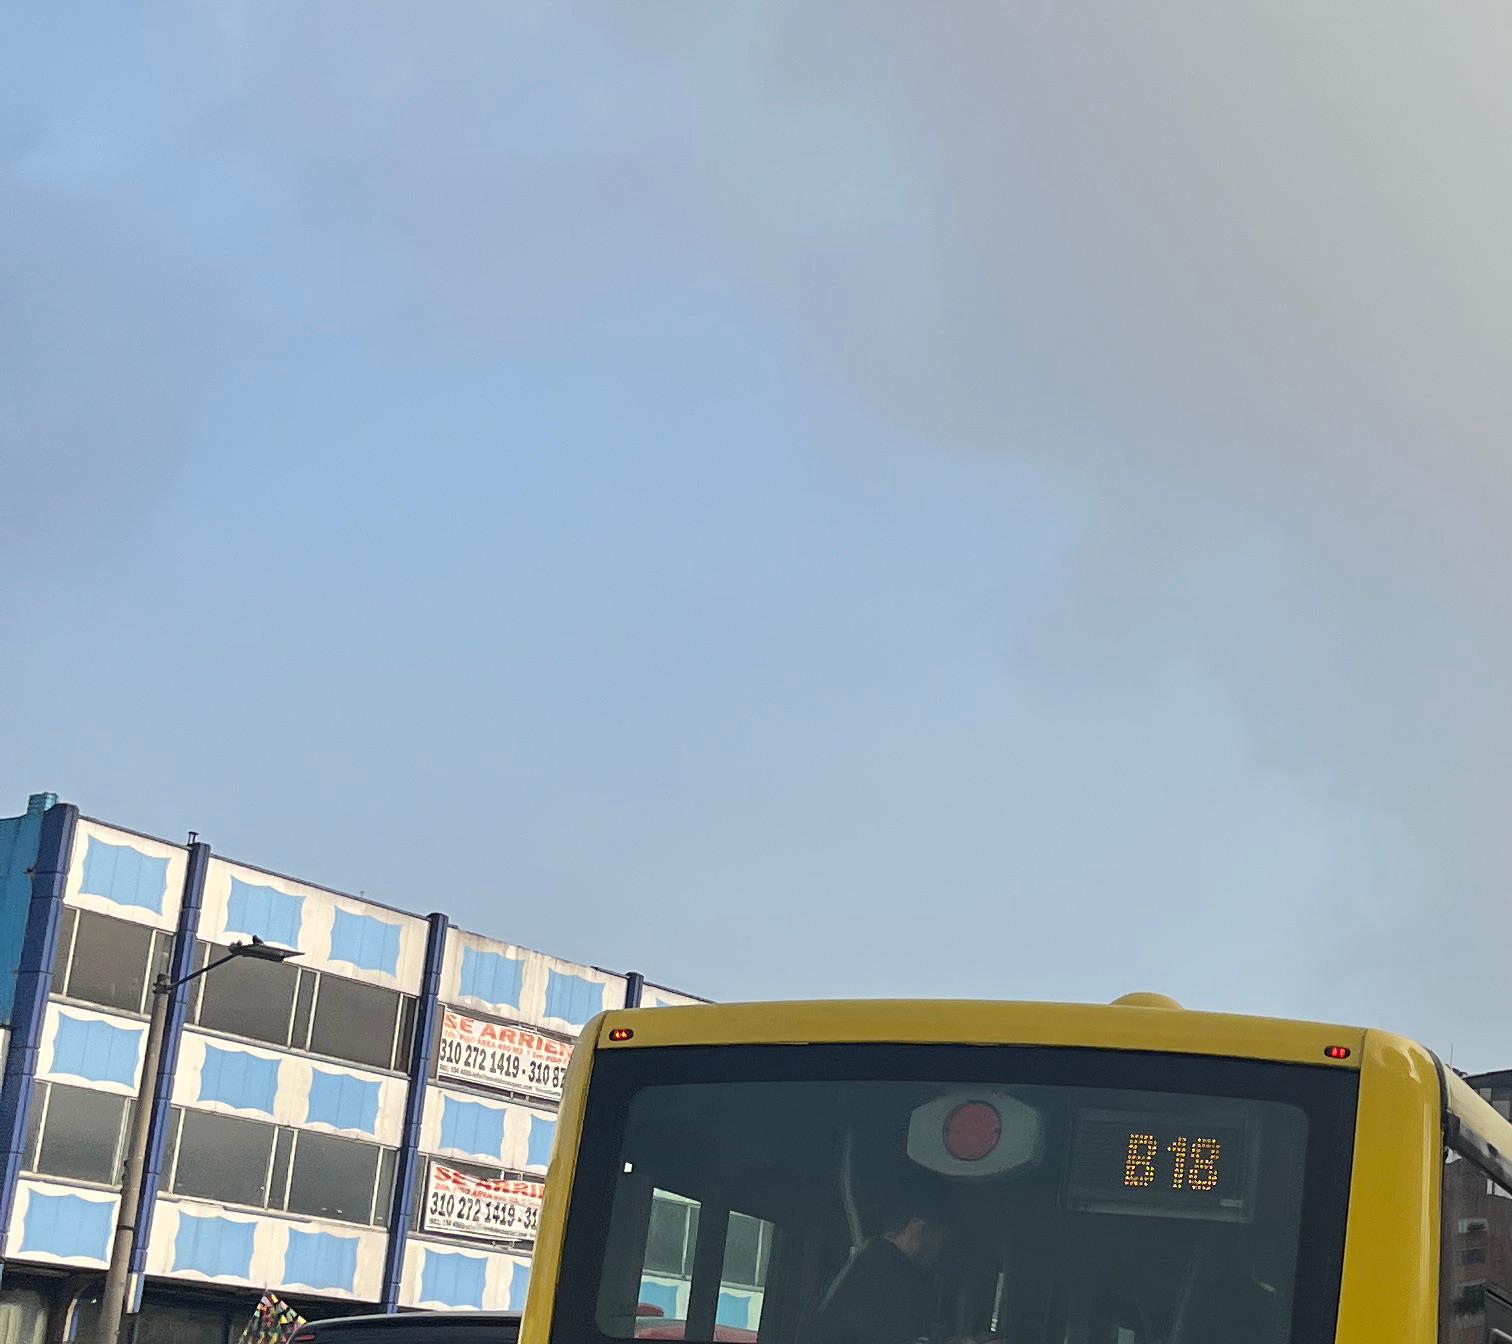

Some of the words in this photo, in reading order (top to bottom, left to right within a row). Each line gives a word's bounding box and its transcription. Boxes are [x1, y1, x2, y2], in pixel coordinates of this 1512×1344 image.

[444, 1014, 474, 1033] SE
[440, 1038, 461, 1064] 310
[464, 1044, 486, 1071] 272
[490, 1050, 519, 1078] 1419
[528, 1060, 550, 1086] 310
[1124, 1134, 1220, 1191] B18
[430, 1191, 455, 1217] 310
[457, 1196, 480, 1222] 272
[484, 1201, 515, 1227] 1419
